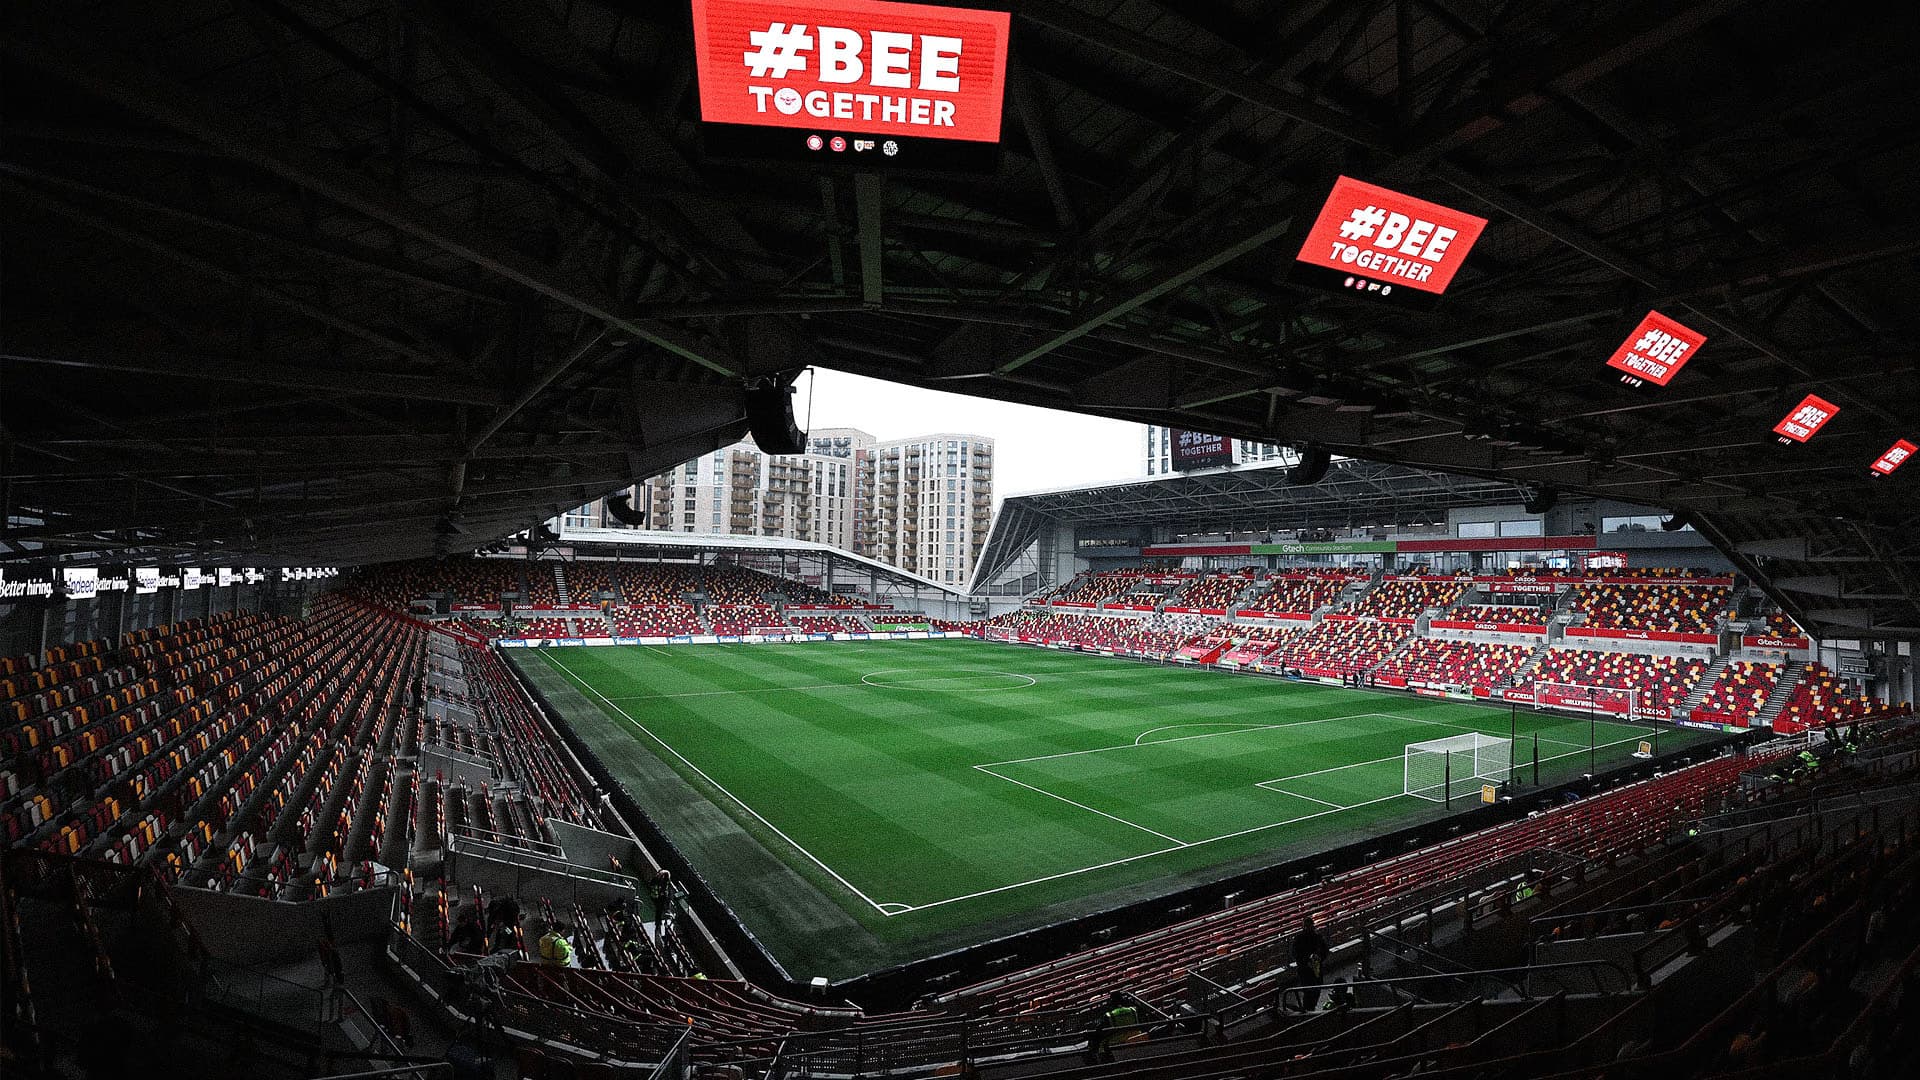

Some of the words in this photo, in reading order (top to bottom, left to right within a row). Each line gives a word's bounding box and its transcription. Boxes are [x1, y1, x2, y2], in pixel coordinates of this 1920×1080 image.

[744, 22, 963, 93] #BEE
[748, 85, 956, 127] TOGETHER
[1338, 205, 1459, 263] #BEE
[1329, 241, 1434, 283] TOGETHER
[1622, 351, 1669, 379] TOGETHER
[1633, 328, 1691, 366] #BEE
[1181, 443, 1222, 456] TOGETHER
[0, 579, 26, 598] Better
[26, 577, 54, 598] hiring.
